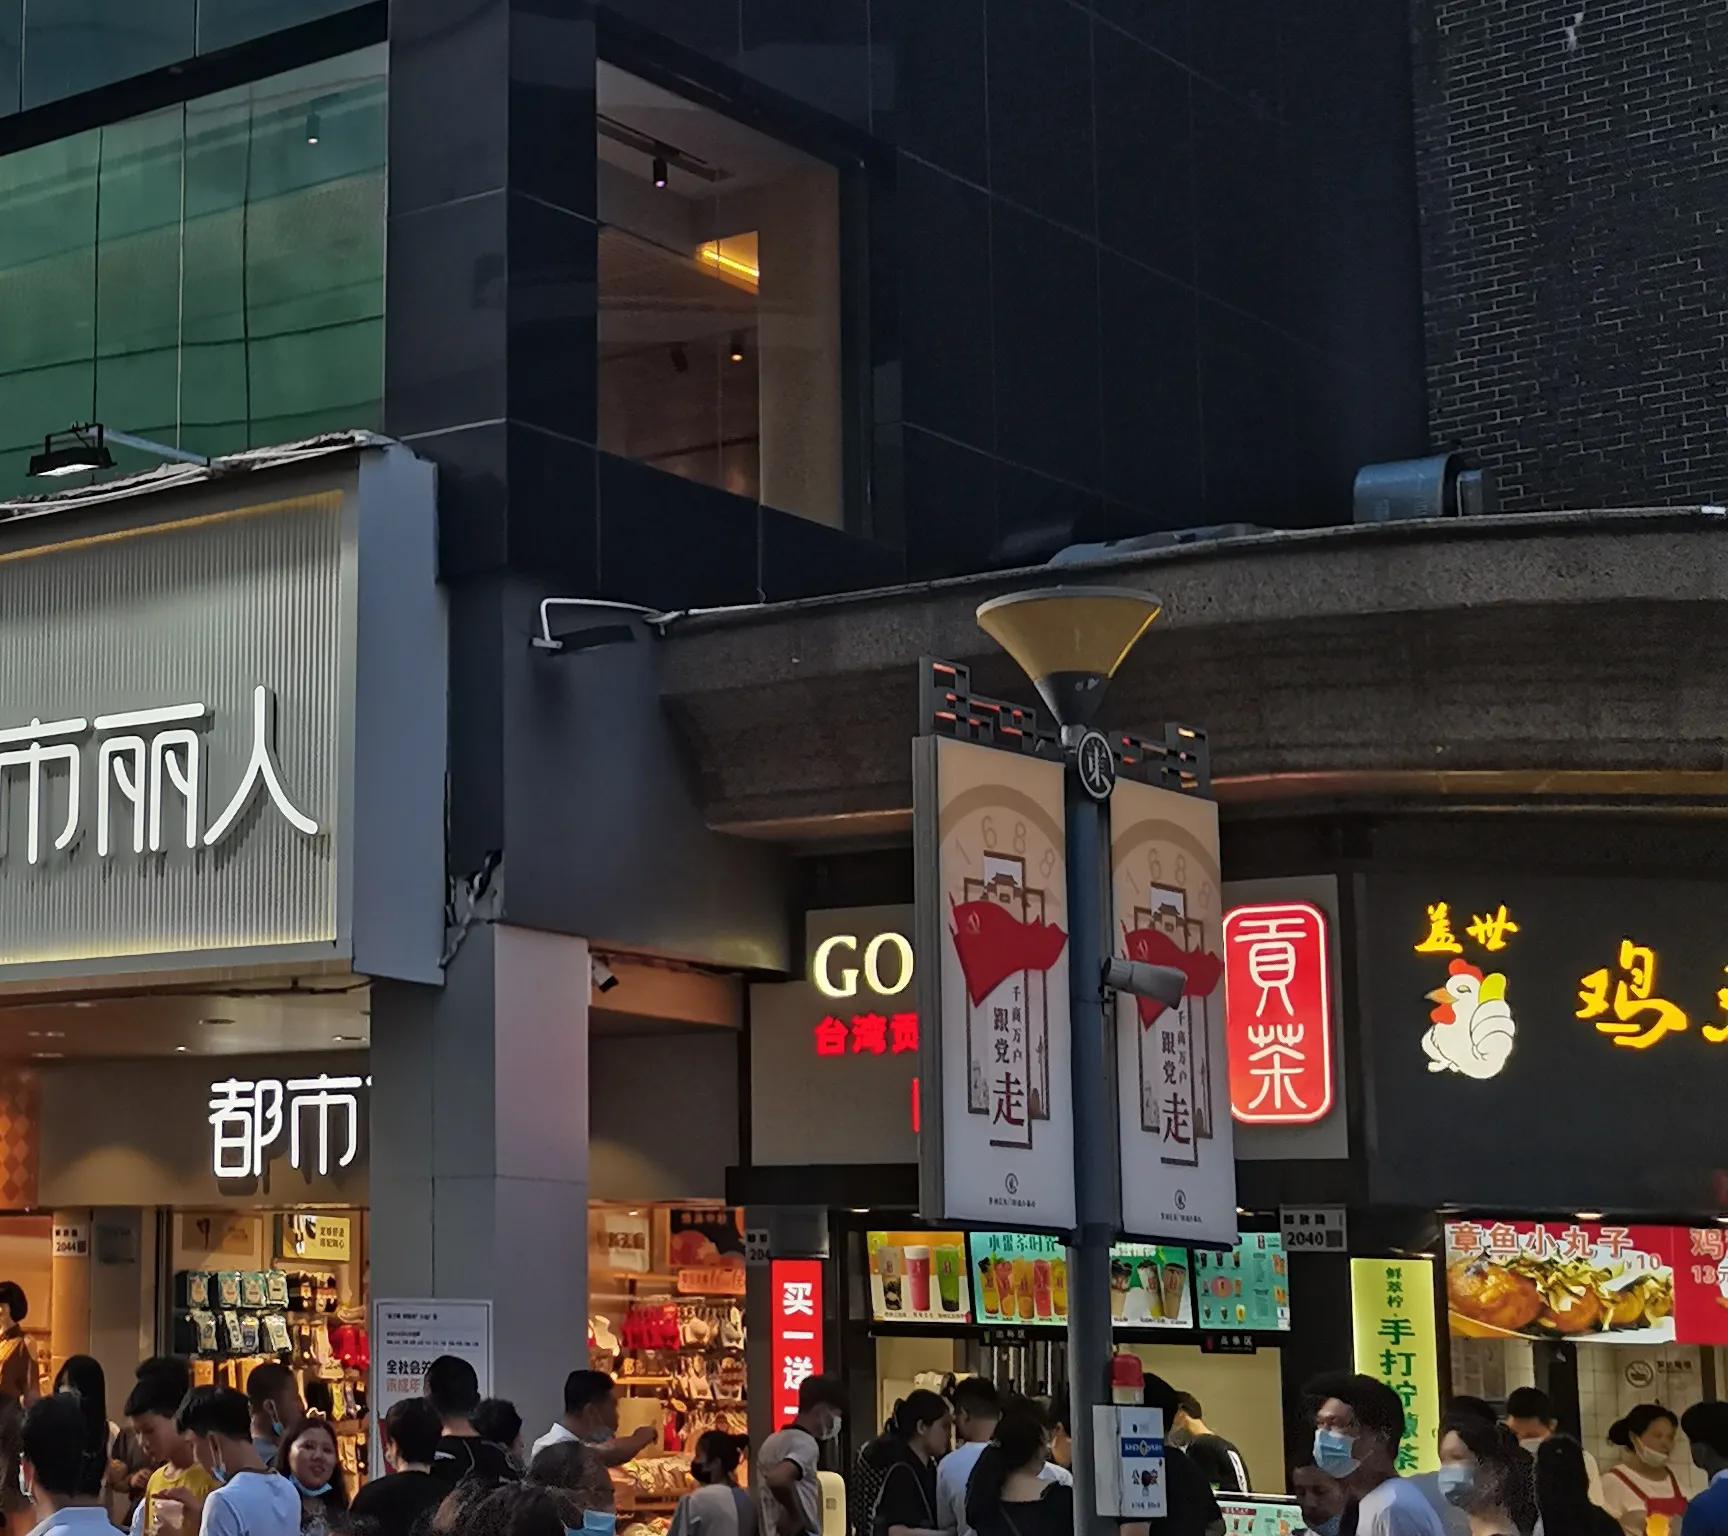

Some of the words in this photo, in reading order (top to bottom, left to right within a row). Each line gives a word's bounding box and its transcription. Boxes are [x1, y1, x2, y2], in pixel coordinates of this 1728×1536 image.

[1414, 901, 1520, 954] 盖世
[813, 932, 914, 998] GO
[1575, 939, 1728, 1049] 鸡
[208, 1075, 372, 1178] 都市
[1287, 1231, 1323, 1246] 2040
[1450, 1221, 1635, 1261] 章鱼小丸子
